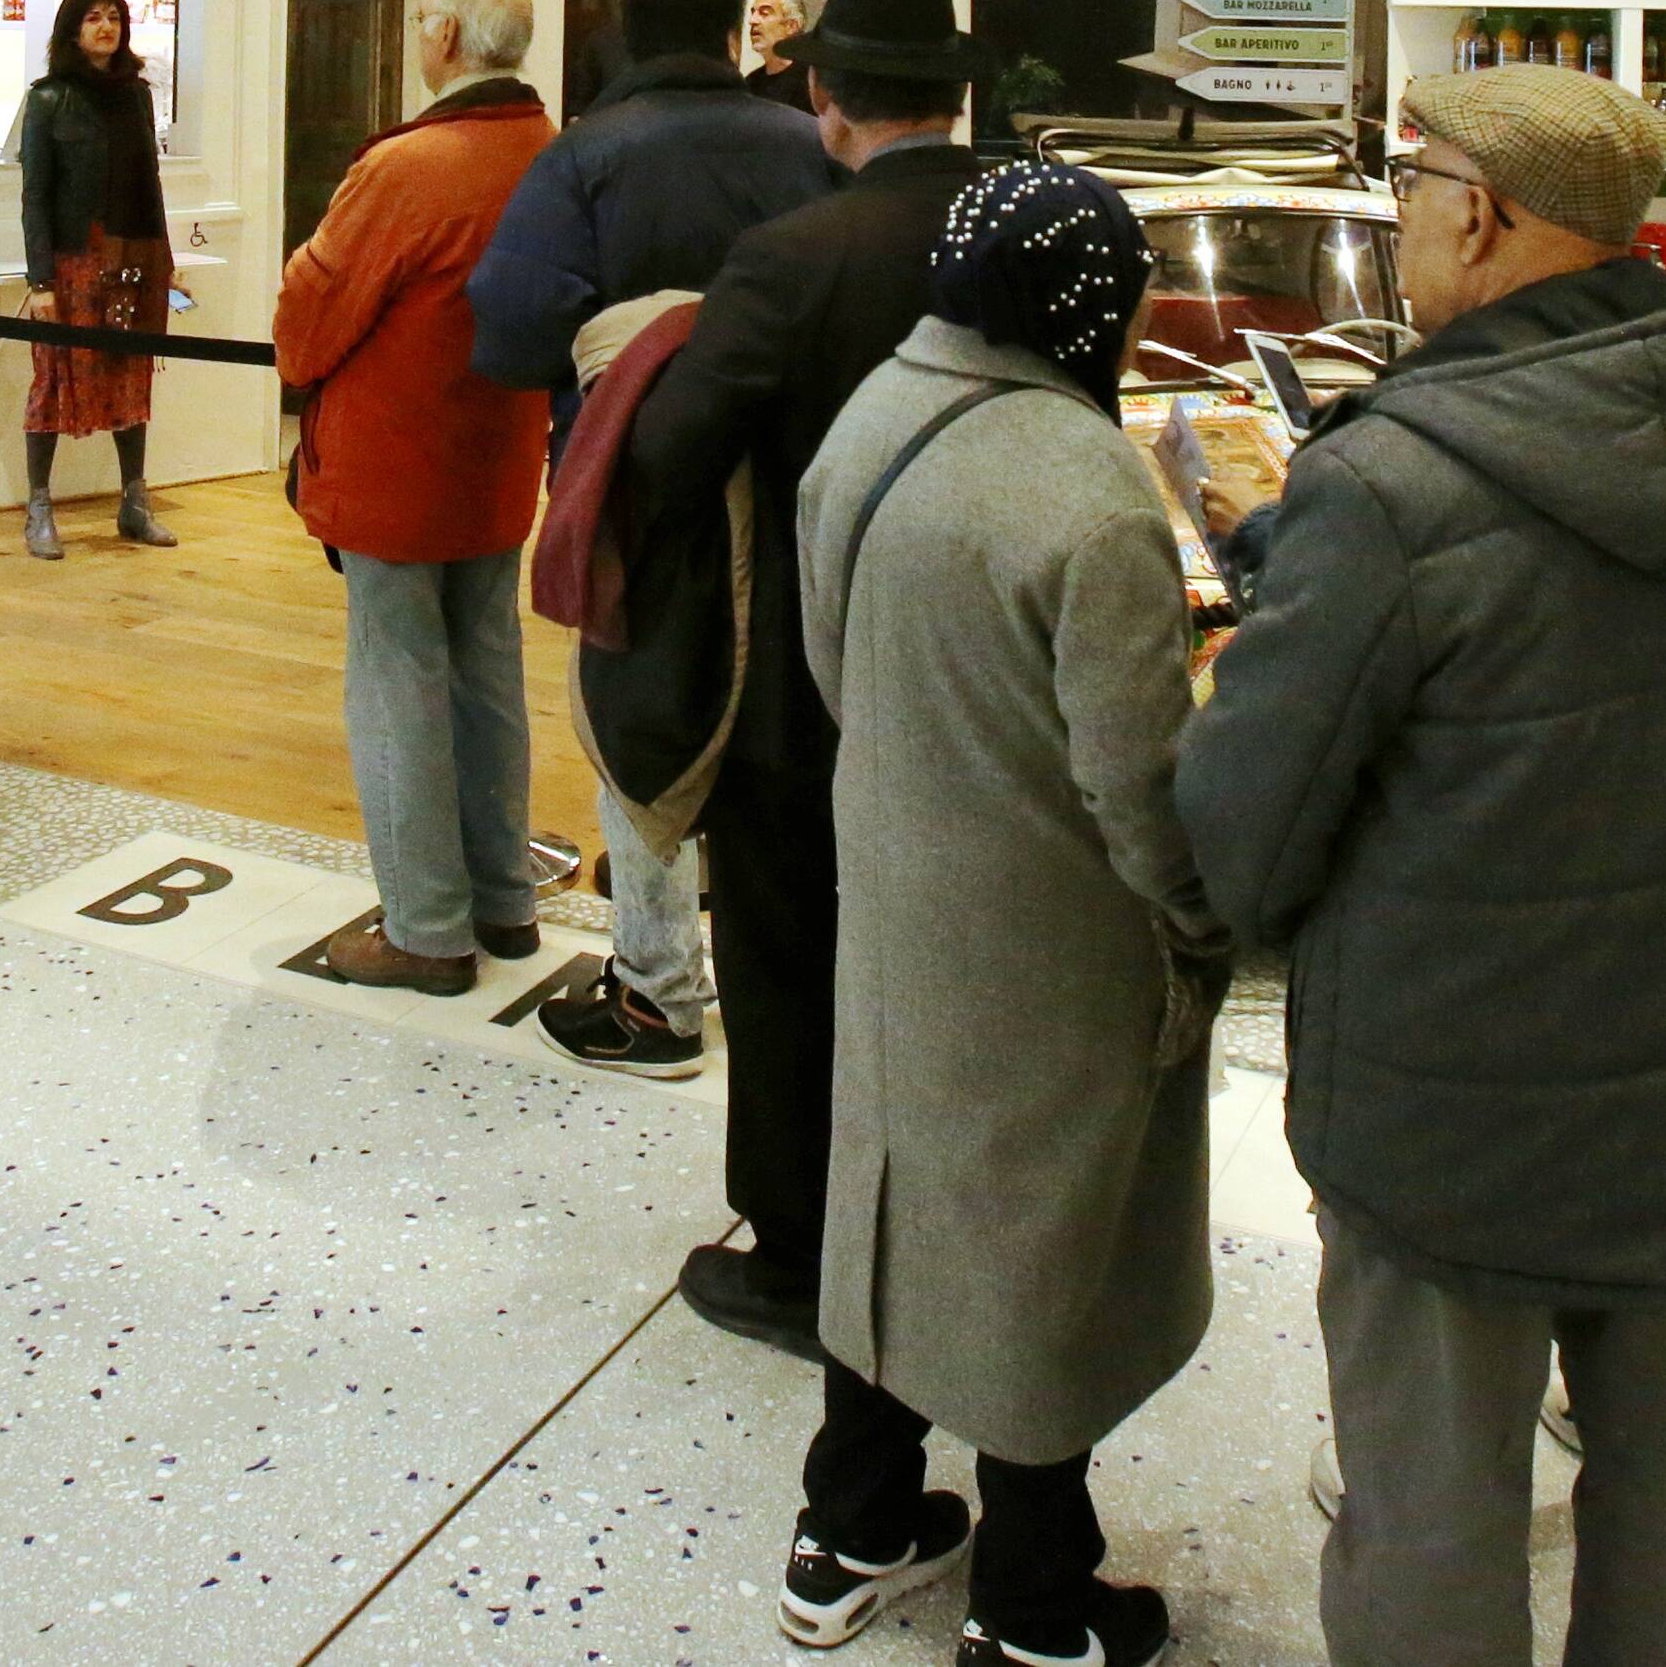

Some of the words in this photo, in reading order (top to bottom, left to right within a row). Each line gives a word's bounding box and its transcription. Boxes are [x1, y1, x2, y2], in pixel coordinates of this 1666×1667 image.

[1223, 0, 1244, 10] BAR
[1247, 0, 1313, 12] MOZZARELLA
[1214, 37, 1237, 49] BAR
[1240, 38, 1300, 51] APERITIVO
[1213, 78, 1252, 91] BAGNO
